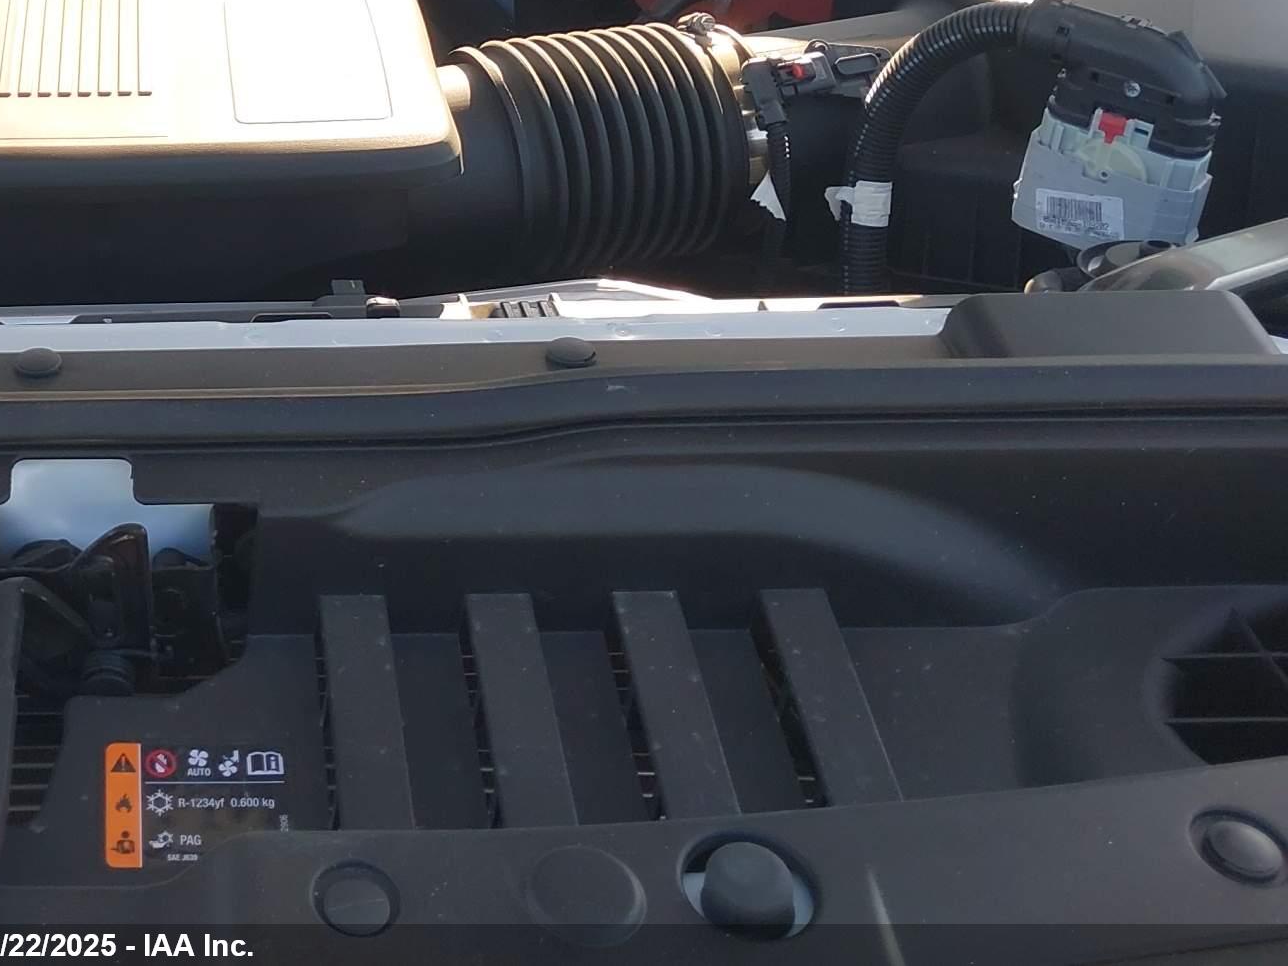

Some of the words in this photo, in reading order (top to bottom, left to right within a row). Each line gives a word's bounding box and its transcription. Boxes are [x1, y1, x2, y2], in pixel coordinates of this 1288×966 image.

[187, 767, 212, 777] AUTO
[178, 797, 225, 809] R-1234yf
[230, 797, 259, 808] 0.600
[261, 797, 275, 809] kg
[179, 834, 202, 846] PAG
